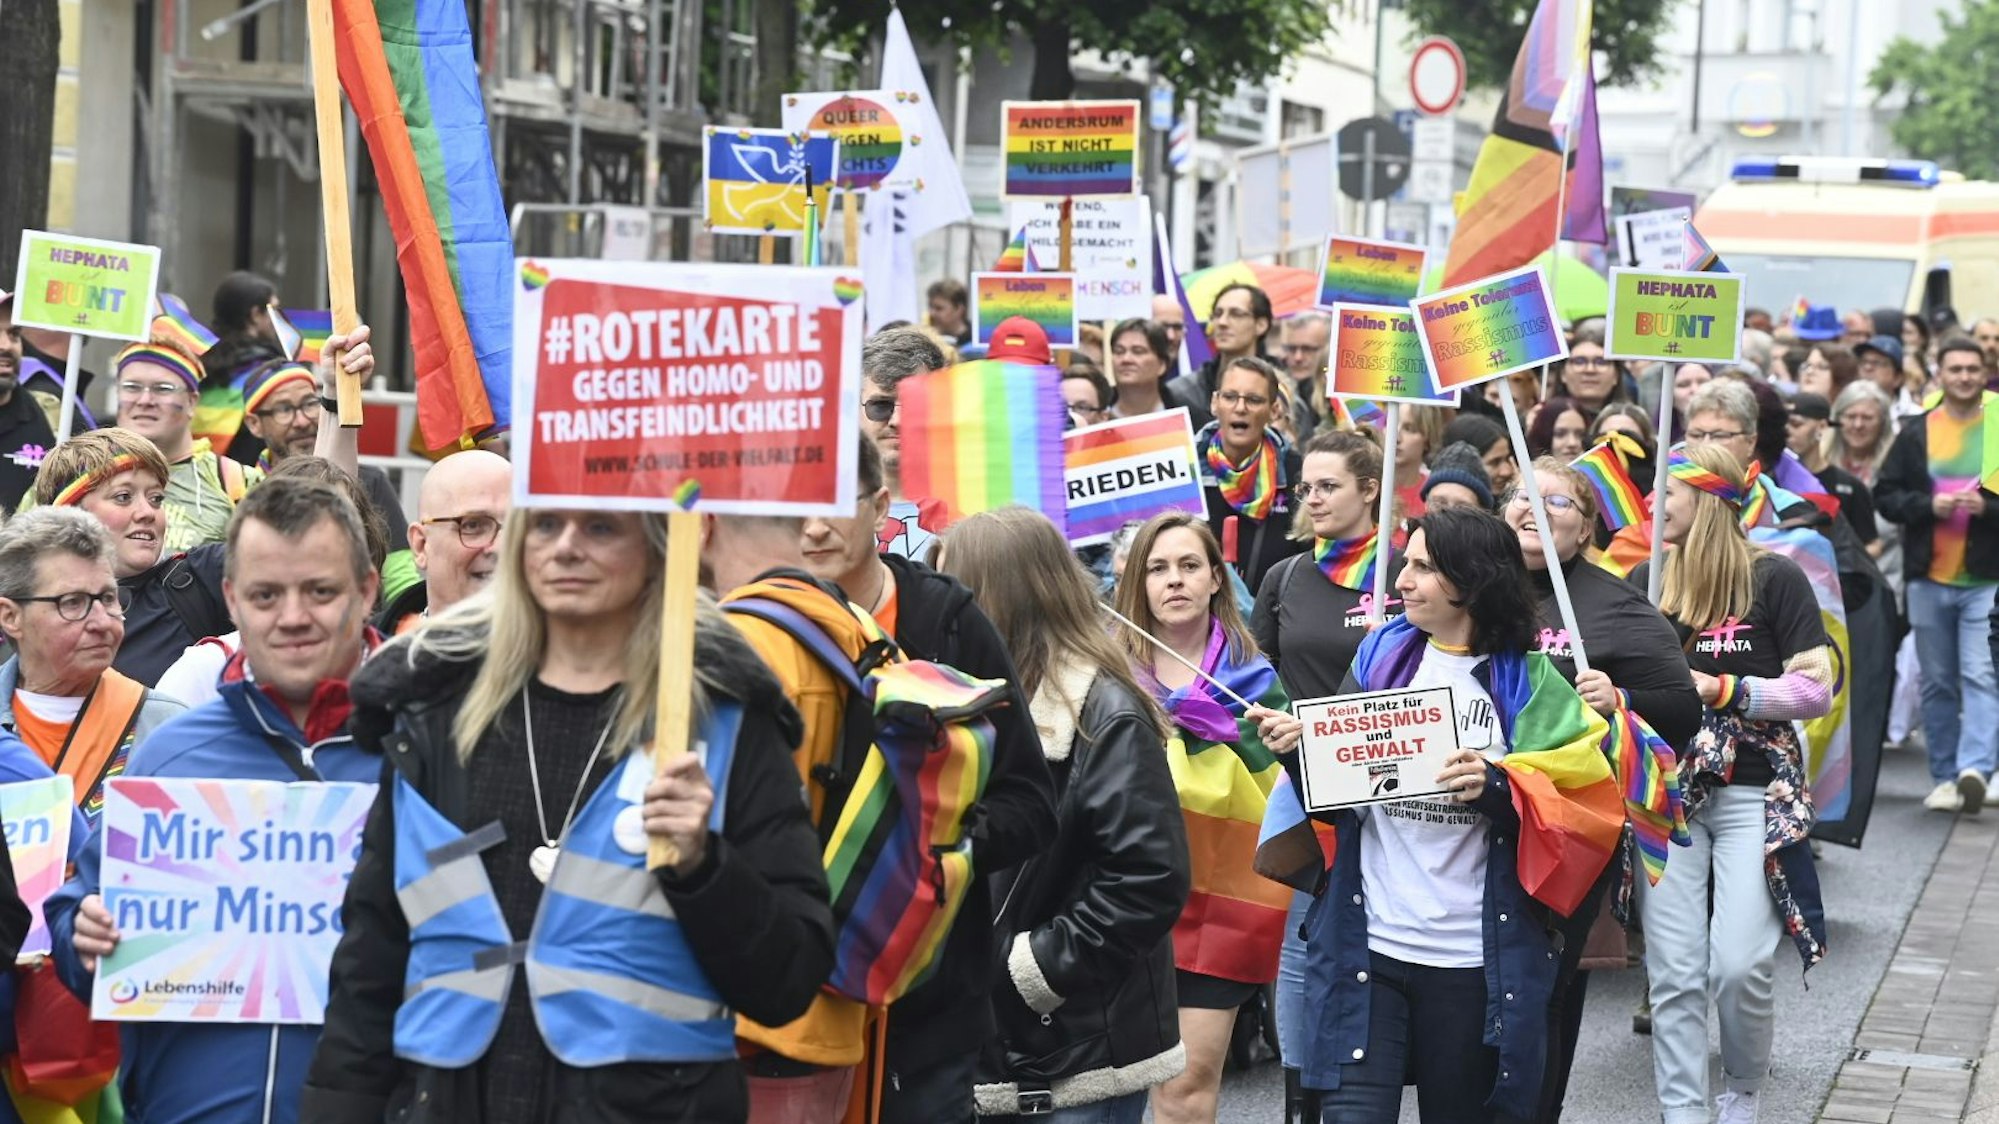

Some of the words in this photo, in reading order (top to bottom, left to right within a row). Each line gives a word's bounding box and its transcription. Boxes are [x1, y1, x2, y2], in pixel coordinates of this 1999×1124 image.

[823, 110, 879, 124] QUEER
[1018, 115, 1124, 129] ANDERSRUM
[841, 134, 880, 146] GEN
[1029, 140, 1056, 152] IST
[1062, 138, 1112, 152] NICHT
[841, 158, 887, 172] CHTS
[1024, 160, 1116, 174] VERKEHRT
[1045, 202, 1106, 213] WEND,
[50, 247, 129, 272] HEPHATA
[45, 279, 126, 313] BUNT
[1637, 280, 1717, 299] HEPHATA
[1424, 301, 1469, 322] Keine
[545, 303, 823, 365] #ROTEKARTE
[1343, 314, 1387, 331] Keine
[1390, 317, 1418, 333] Tol
[1635, 311, 1716, 339] BUNT
[1434, 316, 1549, 362] Rassismus
[1341, 350, 1428, 374] Rassism
[572, 366, 662, 403] GEGEN
[666, 362, 759, 398] HOMO-
[763, 359, 824, 393] UND
[538, 397, 825, 444] TRANSFEINDLICHKEIT
[1066, 459, 1187, 501] RIEDEN.
[1695, 640, 1753, 653] HEPHATA
[1327, 706, 1360, 718] Kein
[1363, 700, 1400, 713] Platz
[1402, 697, 1424, 709] für
[1313, 707, 1442, 738] RASSISMUS
[1366, 729, 1393, 742] und
[1336, 738, 1426, 764] GEWALT
[1425, 813, 1444, 824] UND
[1446, 814, 1477, 825] GEWALT
[140, 812, 225, 860] Mir
[238, 819, 335, 863] sinn
[118, 896, 199, 931] nur
[144, 978, 245, 996] Lebenshilfe
